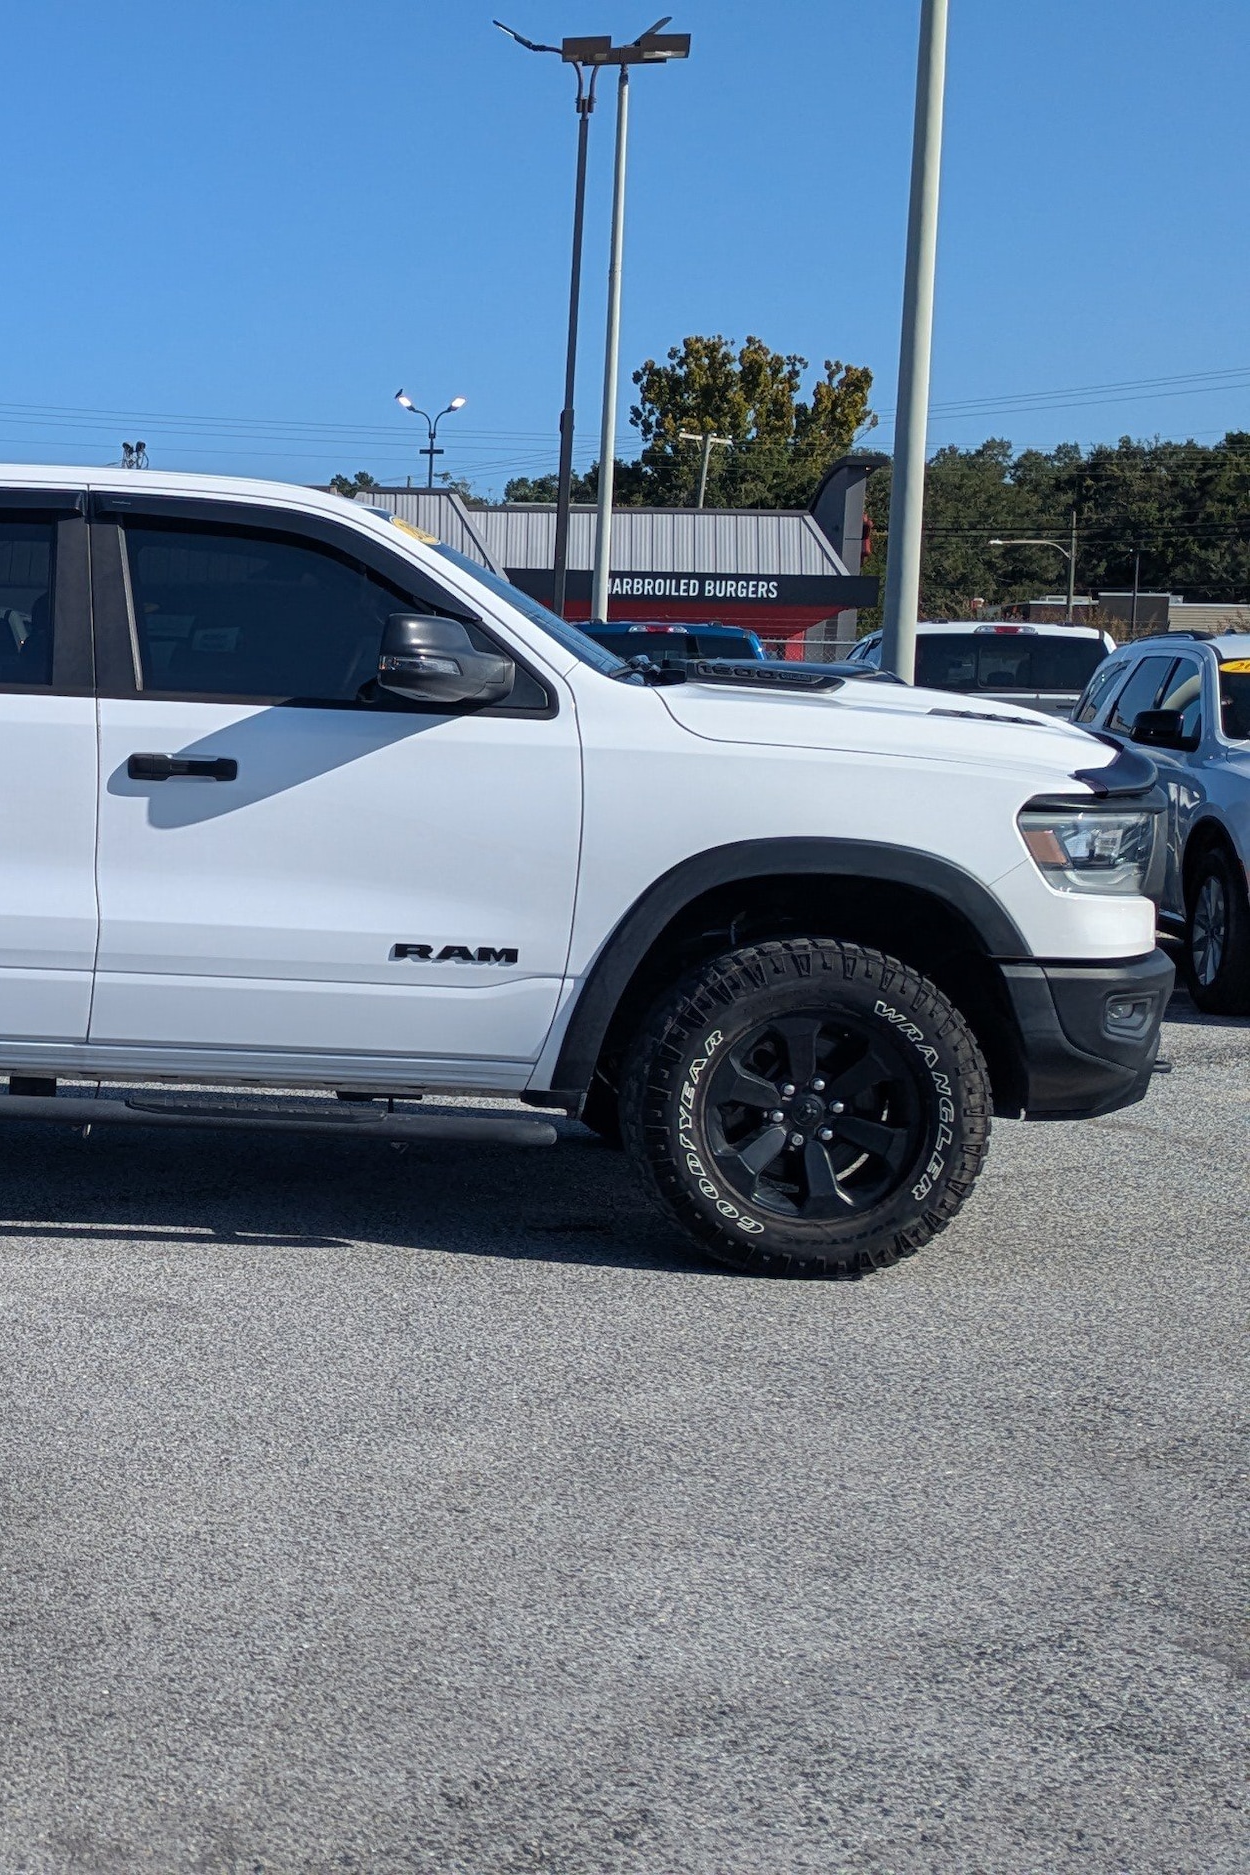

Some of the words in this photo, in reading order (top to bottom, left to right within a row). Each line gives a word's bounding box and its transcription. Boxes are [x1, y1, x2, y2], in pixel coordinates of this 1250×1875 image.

[704, 580, 778, 598] BURGERS
[392, 943, 519, 964] RAM
[678, 1029, 765, 1234] GOODYEAR
[873, 1000, 955, 1201] WRANGLER
